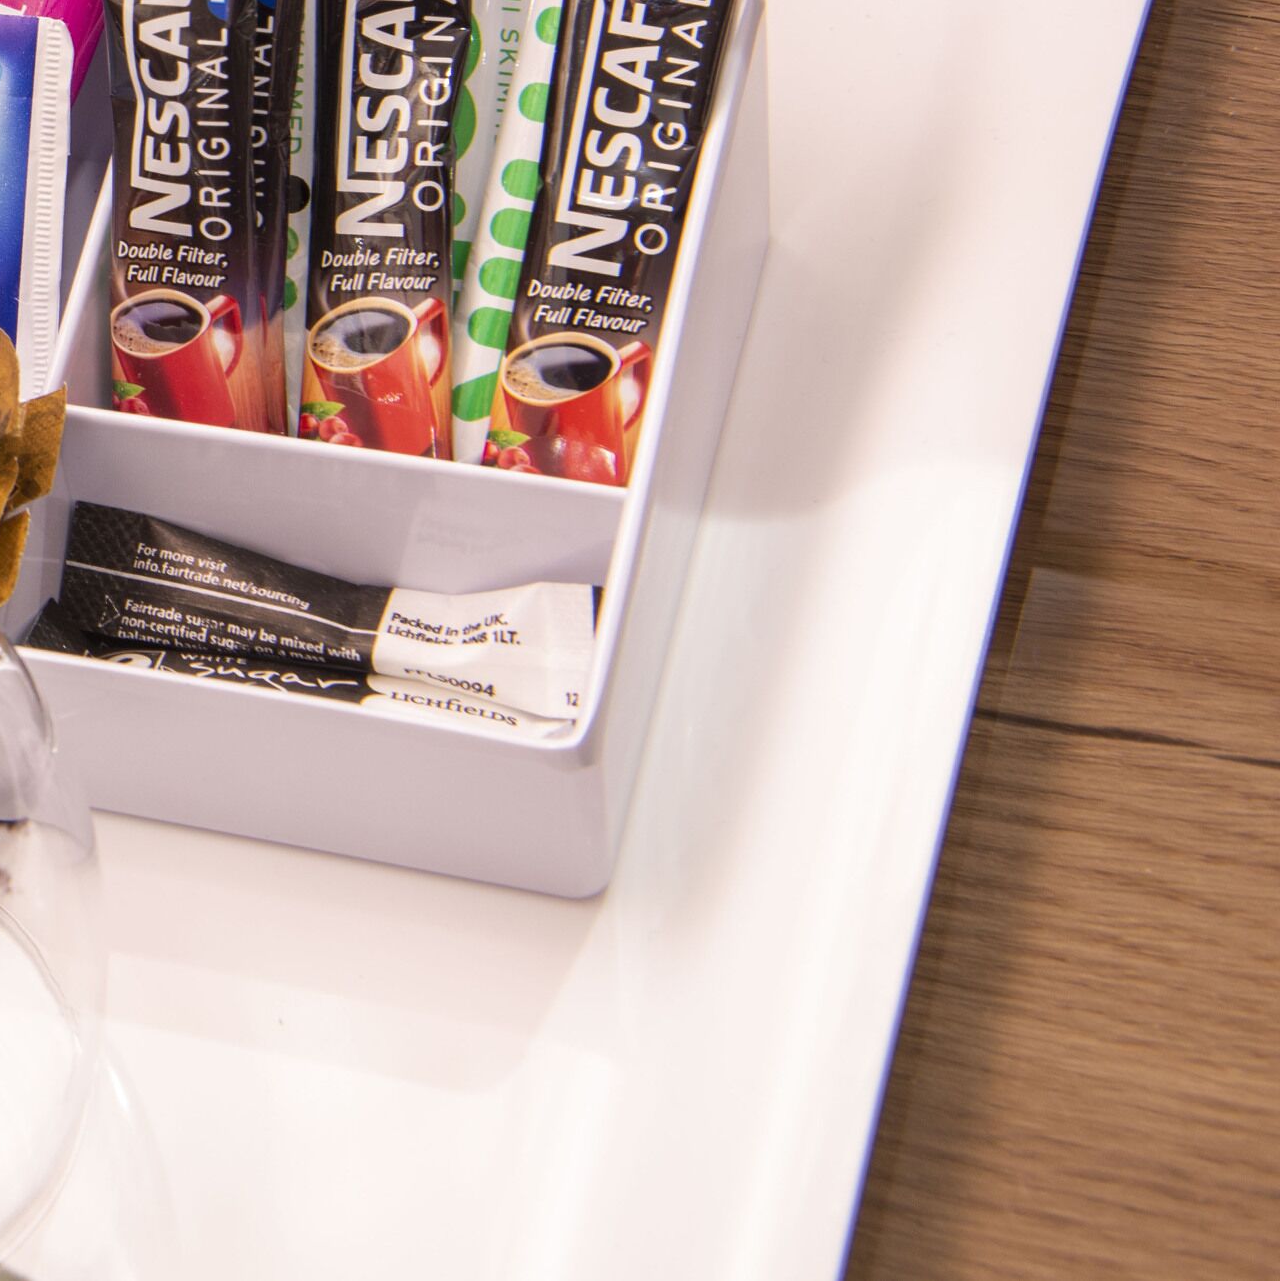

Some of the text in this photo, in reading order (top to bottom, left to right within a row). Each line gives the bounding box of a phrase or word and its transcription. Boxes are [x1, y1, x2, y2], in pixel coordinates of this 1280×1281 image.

[196, 28, 232, 241] ORIGINAL
[118, 241, 229, 268] Double Filter,
[321, 247, 440, 269] Double Filter,
[127, 265, 227, 288] Full Flavour
[330, 272, 438, 292] Full Flavour
[527, 279, 654, 312] Double Filter,
[534, 304, 647, 333] Full Flavour
[137, 542, 228, 574] For more visit
[133, 556, 310, 612] info.fairtrade.net/sourcing
[121, 615, 208, 643] non-certified
[124, 598, 182, 623] Fairtrade
[227, 623, 256, 641] may
[259, 627, 277, 645] be
[280, 635, 325, 655] mixed
[327, 646, 362, 663] with
[391, 612, 509, 637] Packed in the UK.
[190, 661, 360, 695] sugar
